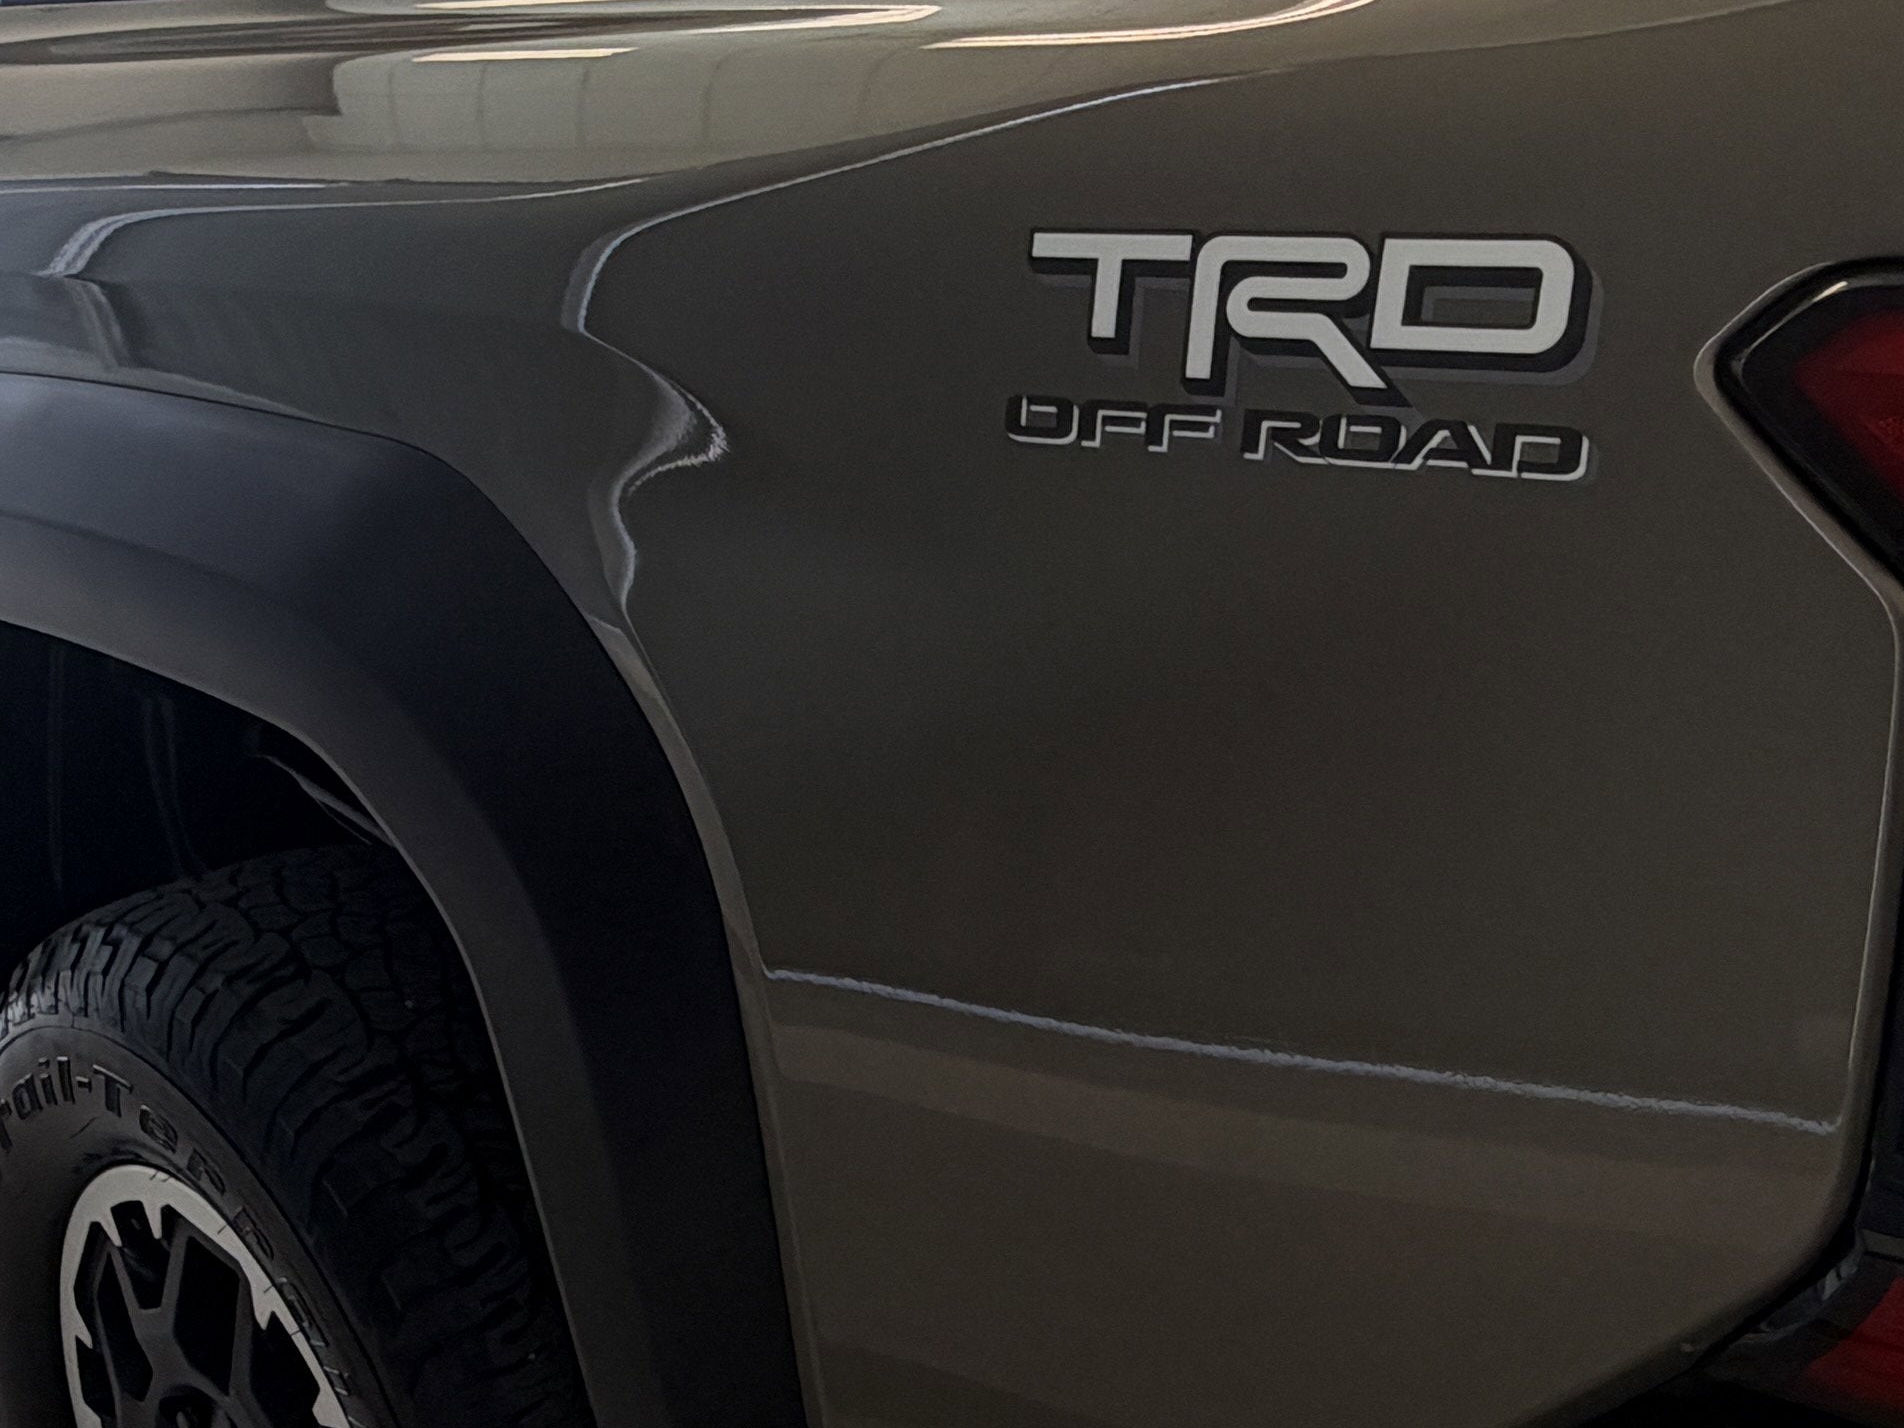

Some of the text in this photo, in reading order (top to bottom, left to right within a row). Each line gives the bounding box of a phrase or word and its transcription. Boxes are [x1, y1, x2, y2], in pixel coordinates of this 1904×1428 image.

[1029, 228, 1598, 408] TRD
[1005, 394, 1592, 482] OFF ROAD
